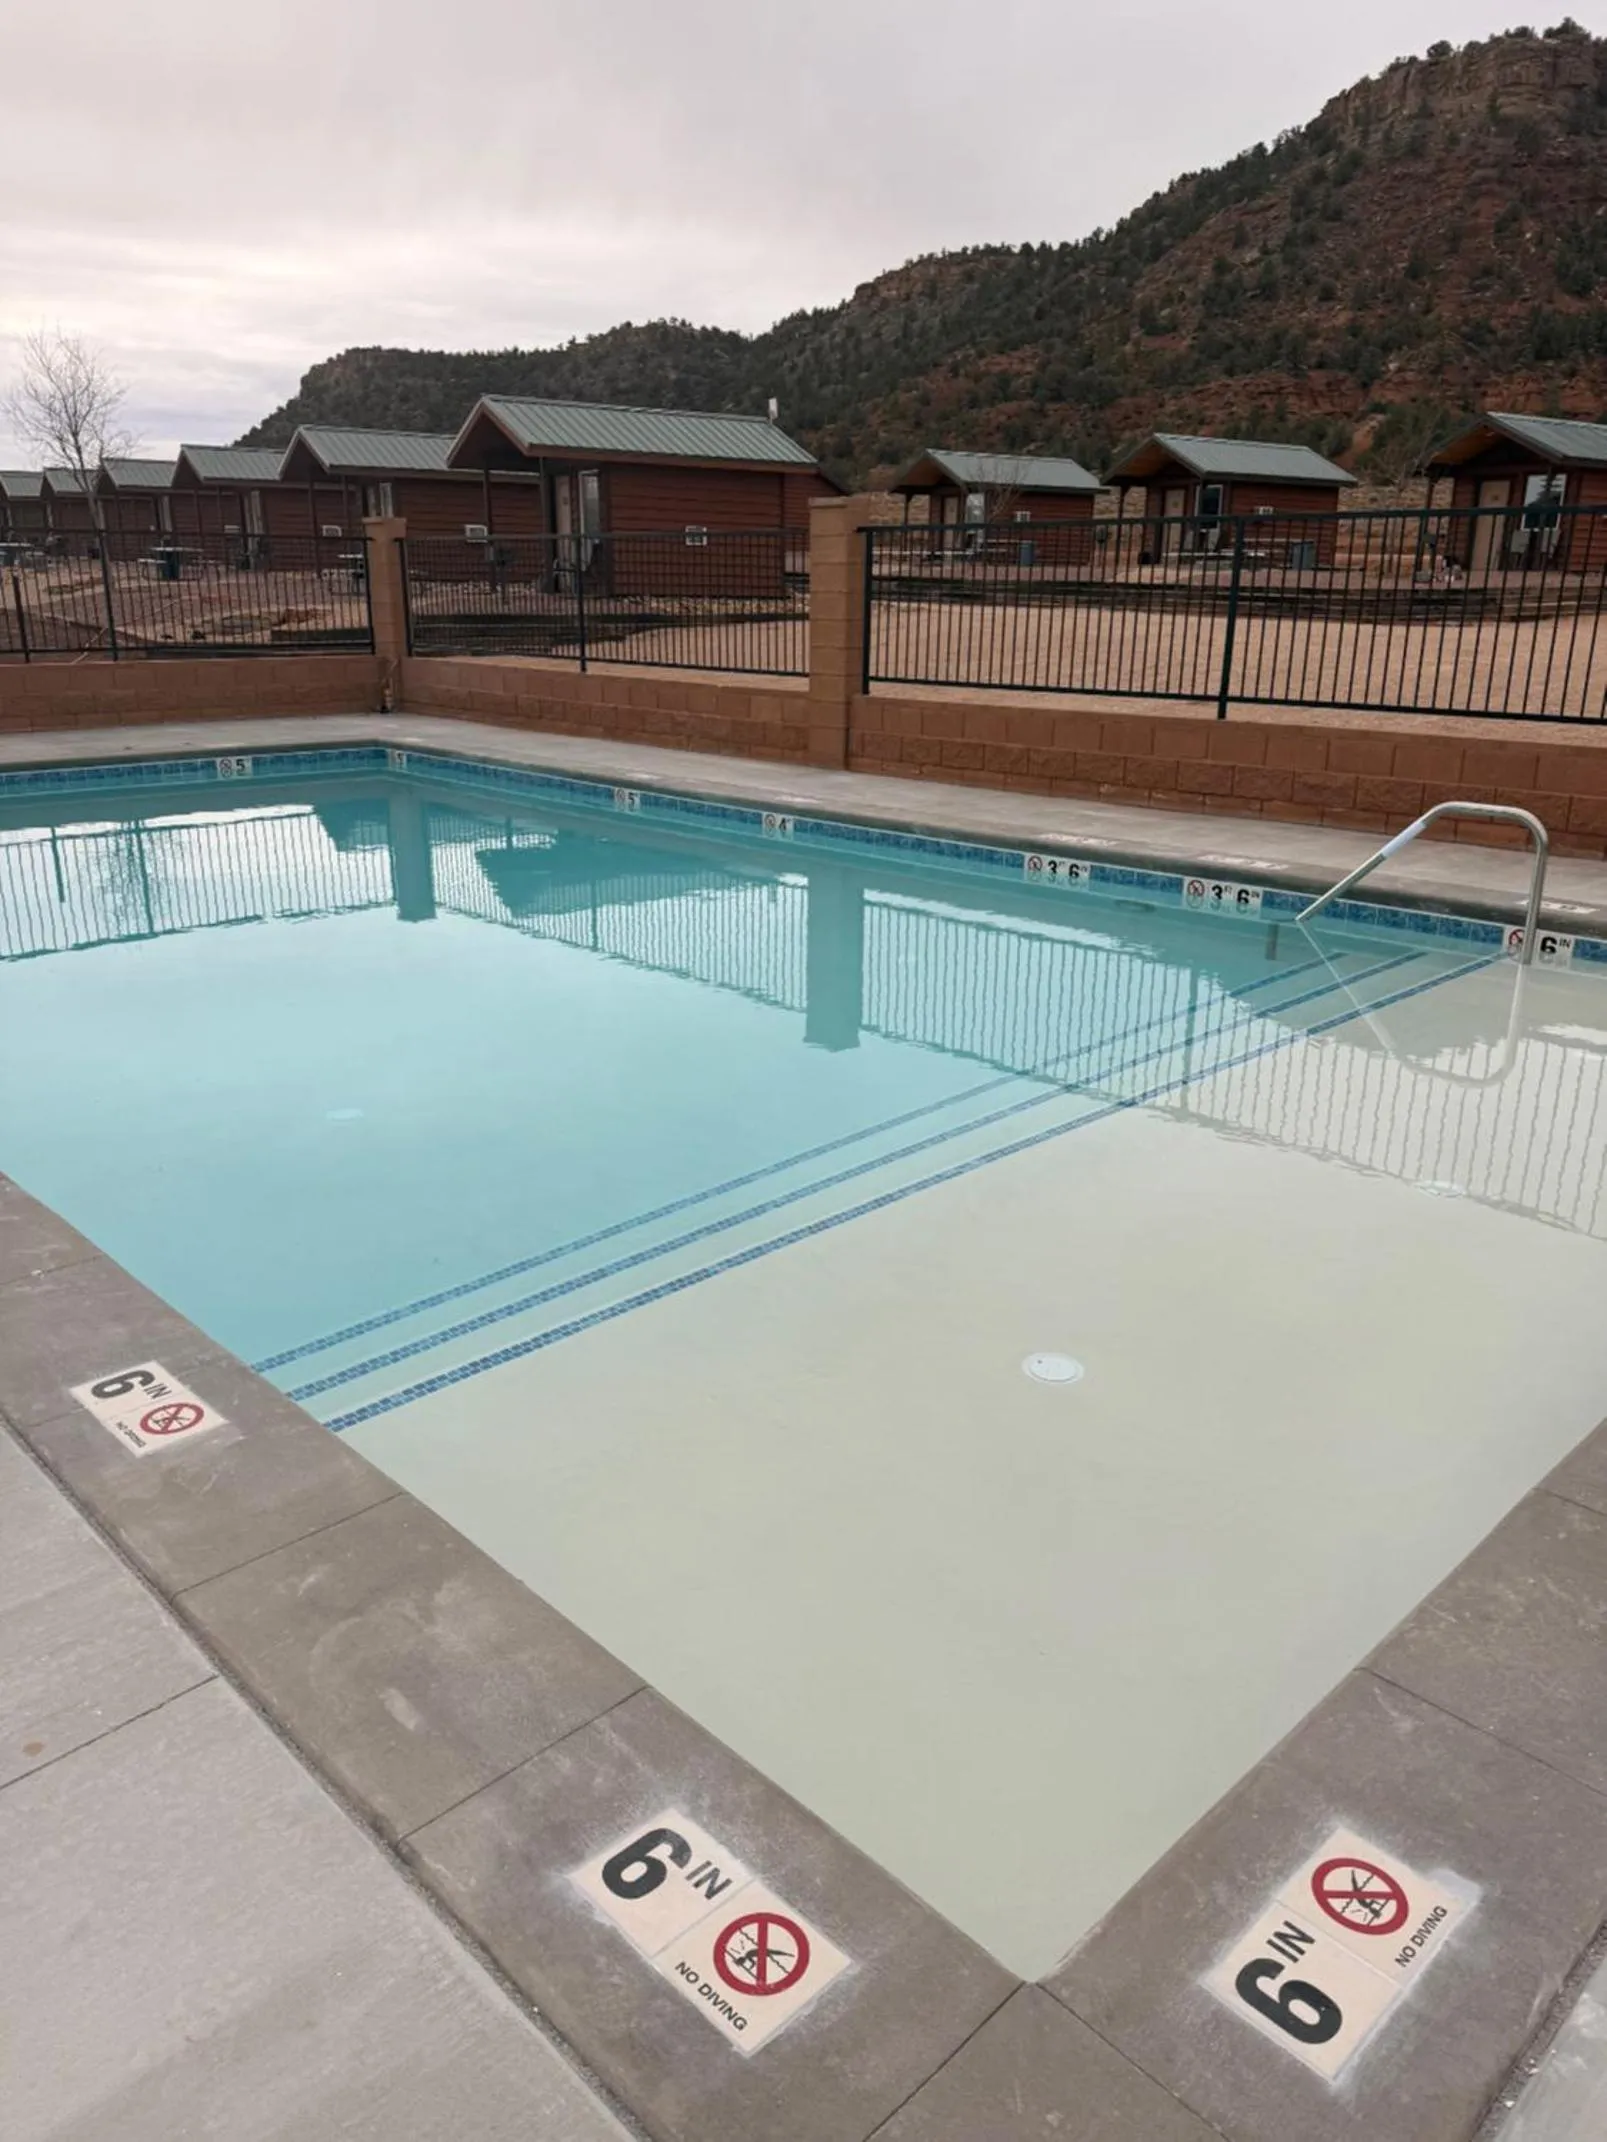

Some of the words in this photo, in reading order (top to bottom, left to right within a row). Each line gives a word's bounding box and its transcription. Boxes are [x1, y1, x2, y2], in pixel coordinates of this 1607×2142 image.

[235, 758, 246, 773] 5
[1047, 860, 1058, 875] 3
[1068, 863, 1080, 879] 6
[1211, 885, 1224, 901] 3
[1237, 889, 1250, 904] 6
[1540, 936, 1558, 954] 6
[91, 1369, 156, 1399] 6
[144, 1382, 172, 1400] IN
[601, 1827, 693, 1900] 6
[685, 1860, 732, 1901] IN
[1266, 1919, 1316, 1964] IN
[1394, 1946, 1418, 1968] NO
[1416, 1905, 1448, 1948] DIVING
[674, 1961, 700, 1985] NO
[697, 1981, 748, 2032] DIVING
[1234, 1957, 1343, 2045] 6
